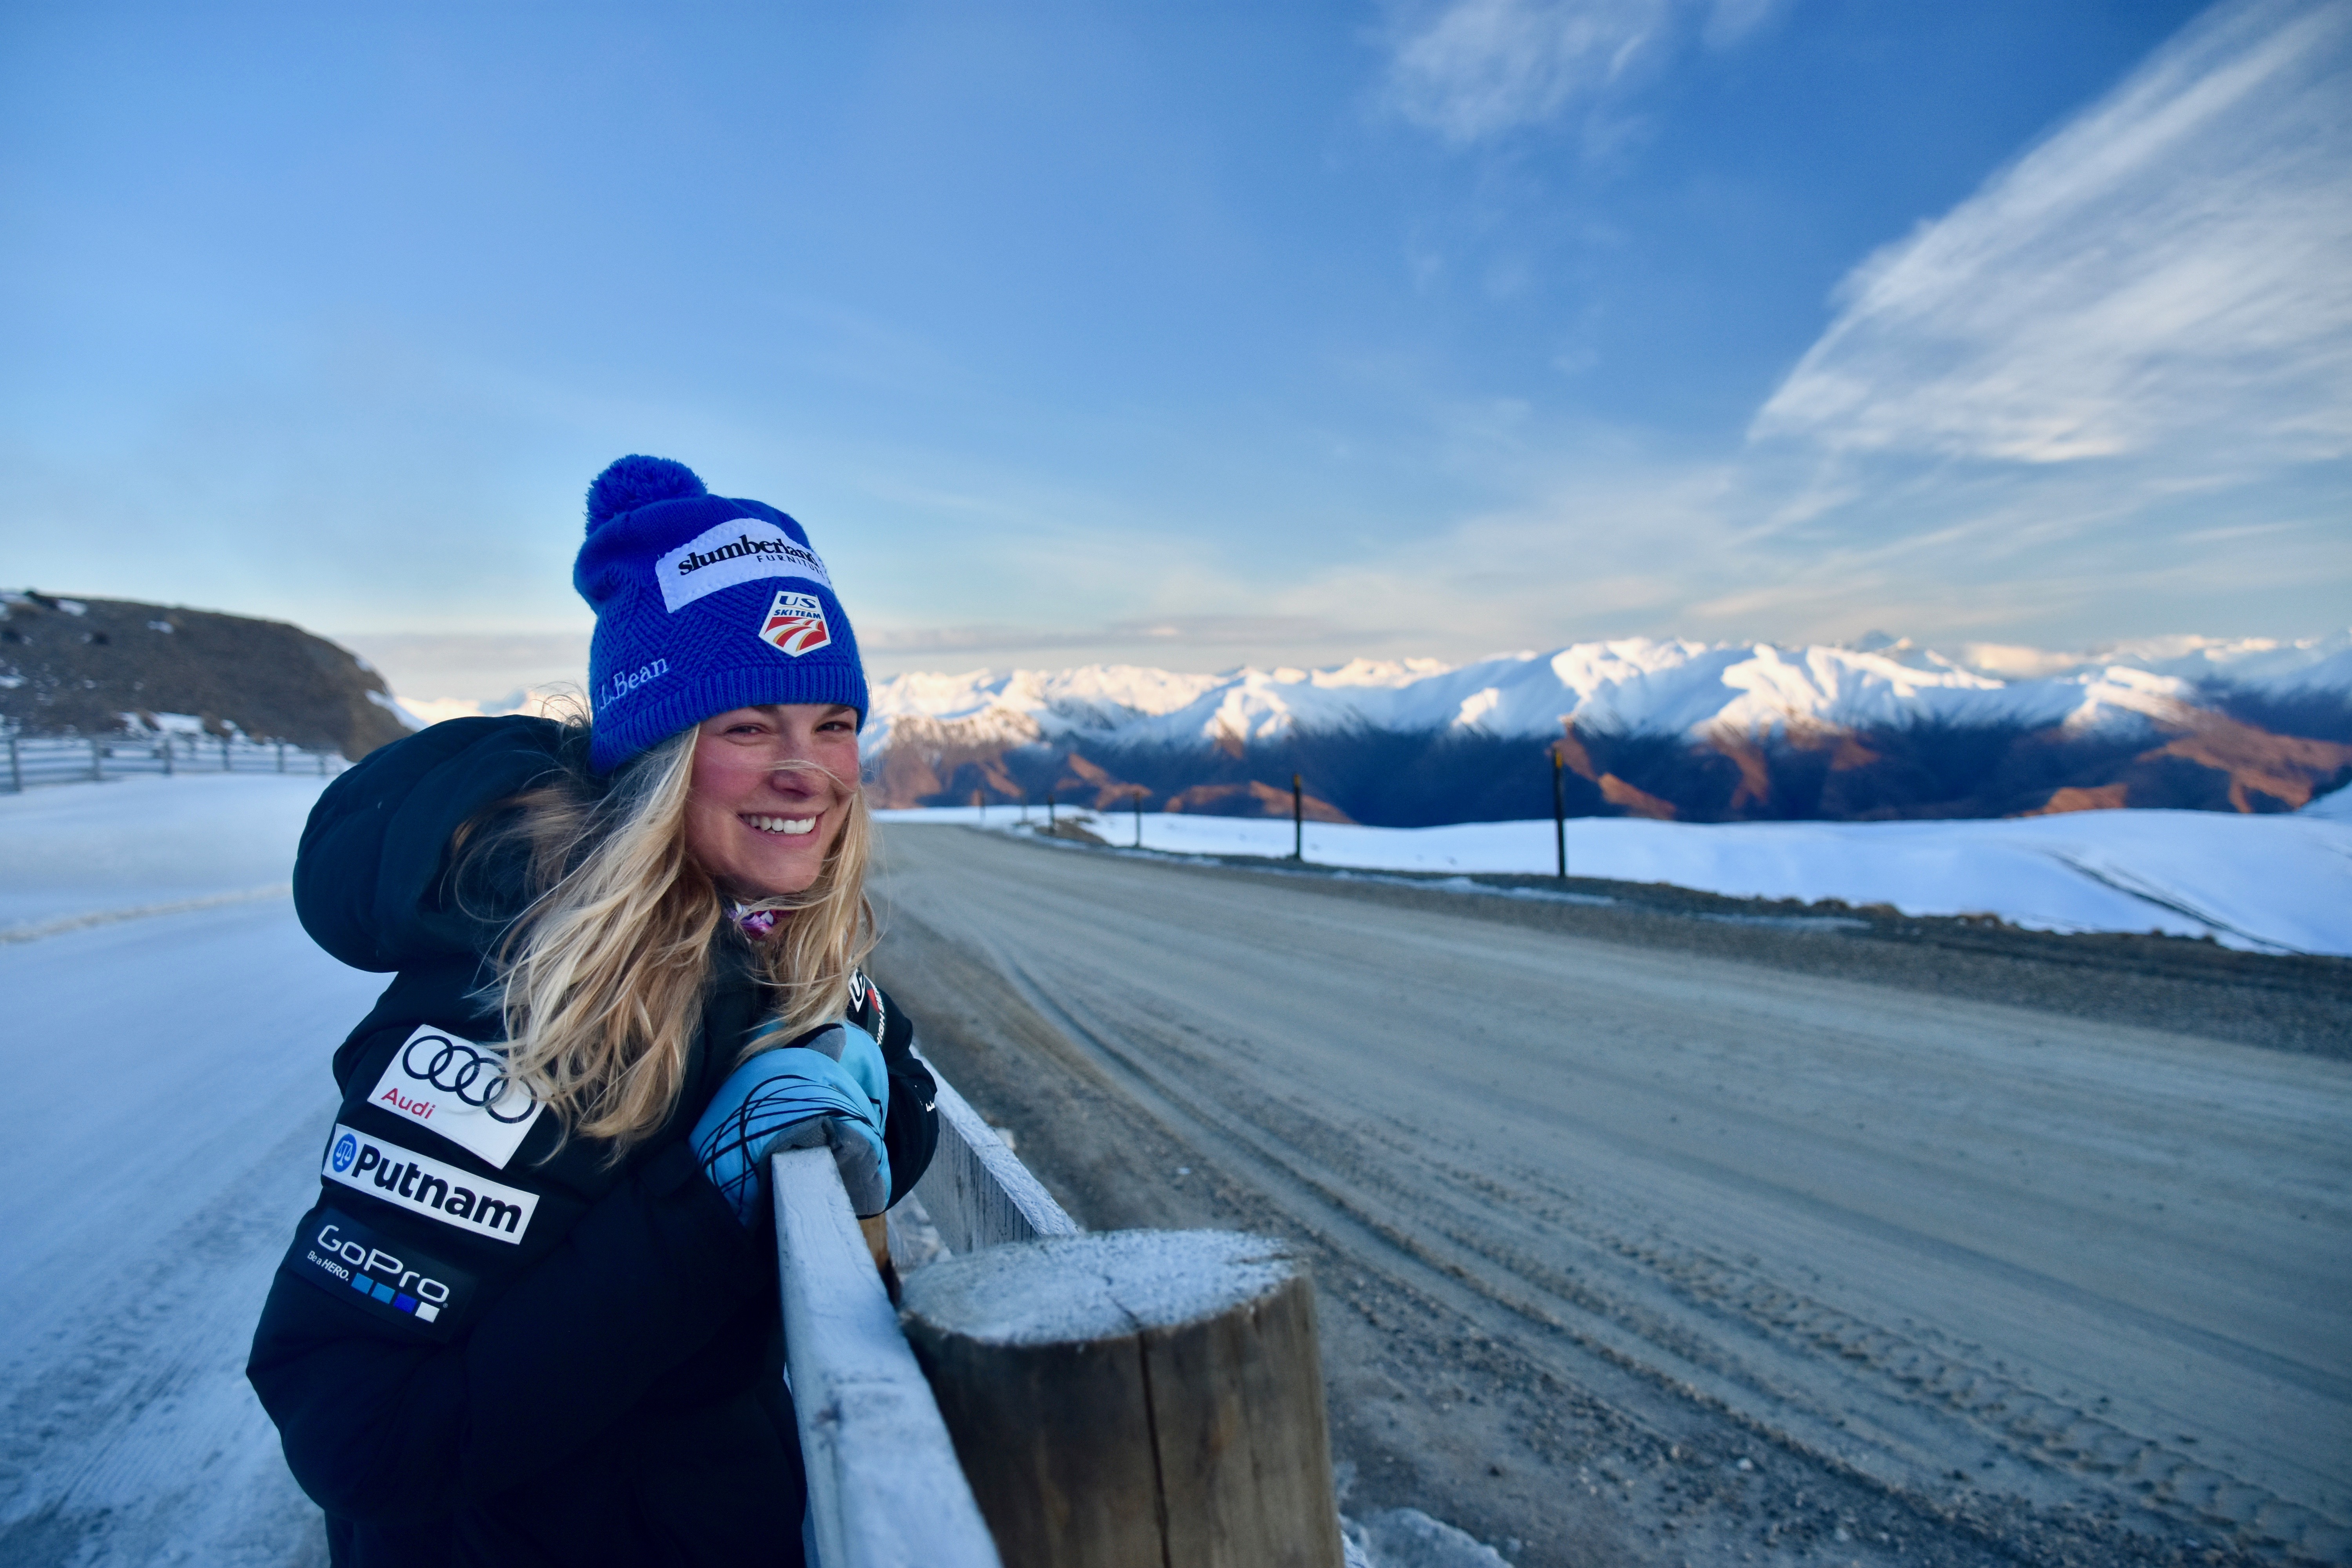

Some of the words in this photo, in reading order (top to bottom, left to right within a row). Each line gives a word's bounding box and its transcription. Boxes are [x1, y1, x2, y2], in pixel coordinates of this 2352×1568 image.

[678, 534, 820, 575] slumberland
[779, 595, 816, 608] US
[795, 610, 822, 619] TEAM
[381, 1087, 436, 1120] Audi
[351, 1143, 522, 1234] Putnam
[307, 1250, 318, 1262] Be
[321, 1259, 349, 1281] HERO.
[318, 1225, 450, 1303] GoPro
